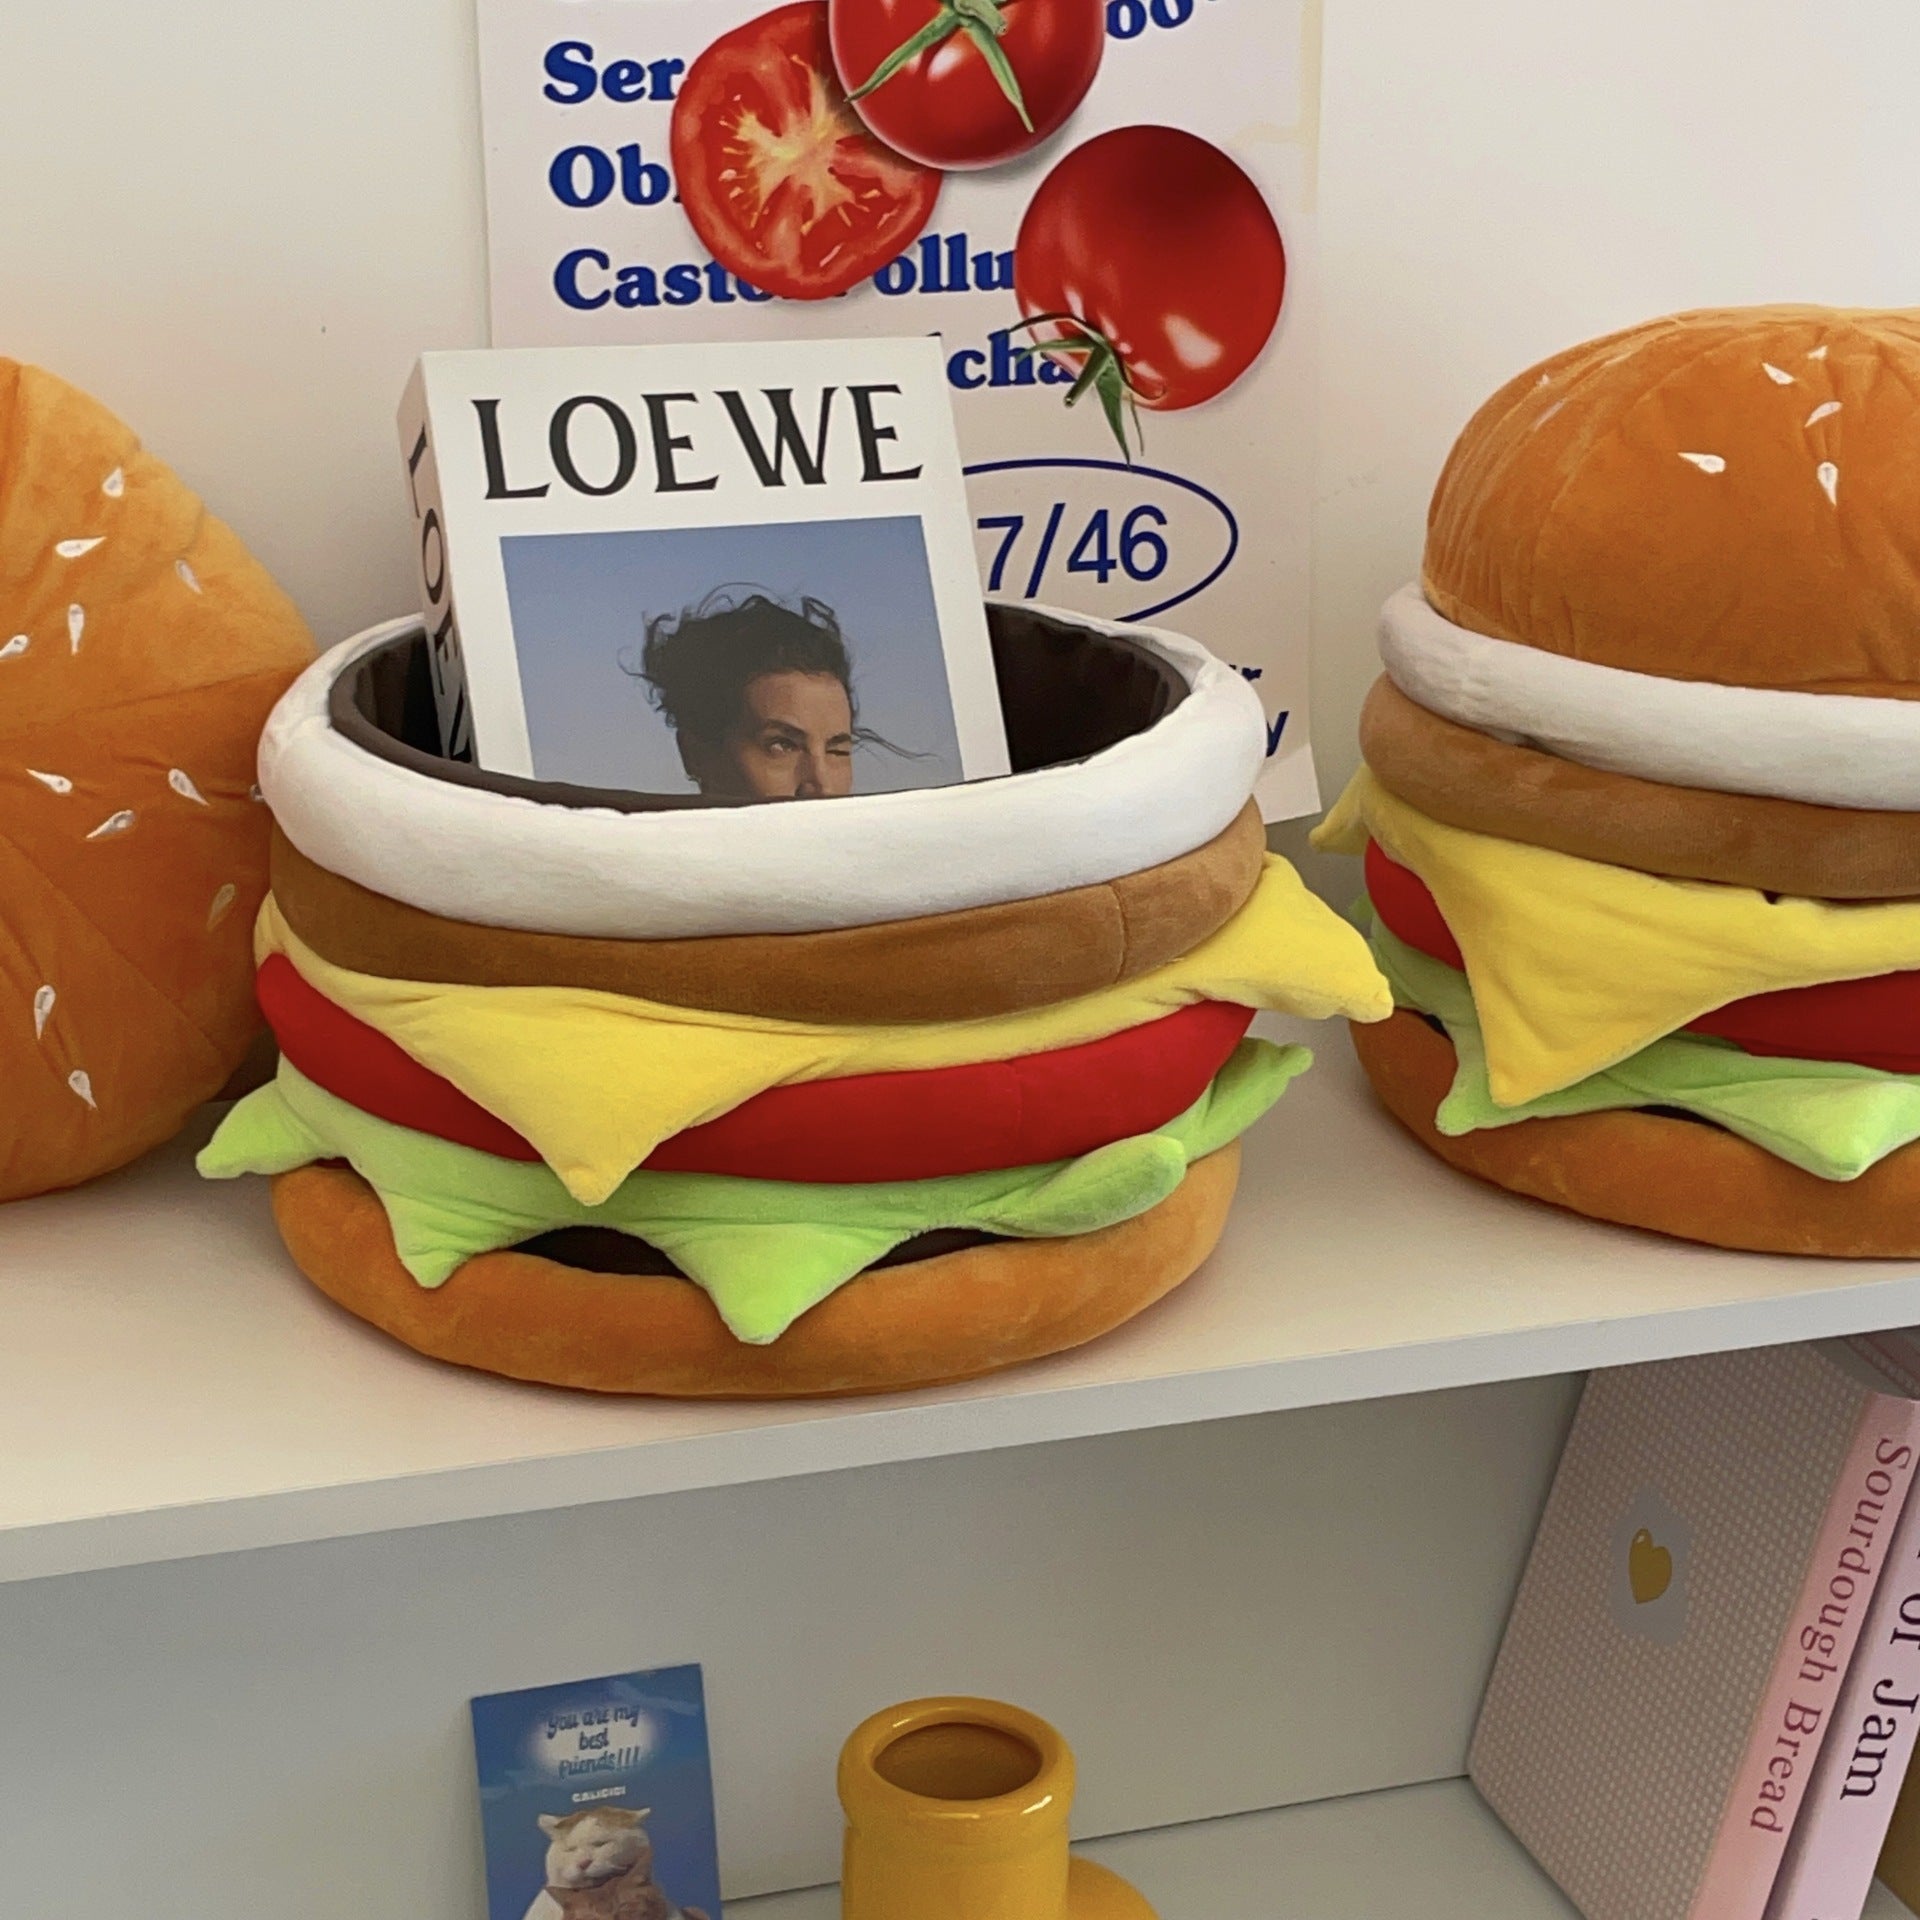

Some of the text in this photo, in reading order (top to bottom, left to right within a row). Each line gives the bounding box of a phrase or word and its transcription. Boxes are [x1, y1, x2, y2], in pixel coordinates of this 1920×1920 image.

[549, 143, 683, 207] Ob
[554, 233, 1014, 310] Cast ollu
[927, 329, 1078, 390] cha
[471, 383, 924, 500] LOEWE
[1750, 1438, 1912, 1834] Sourdough Bread
[579, 1727, 610, 1751] best
[614, 1704, 641, 1728] my
[1839, 1678, 1920, 1801] Jam
